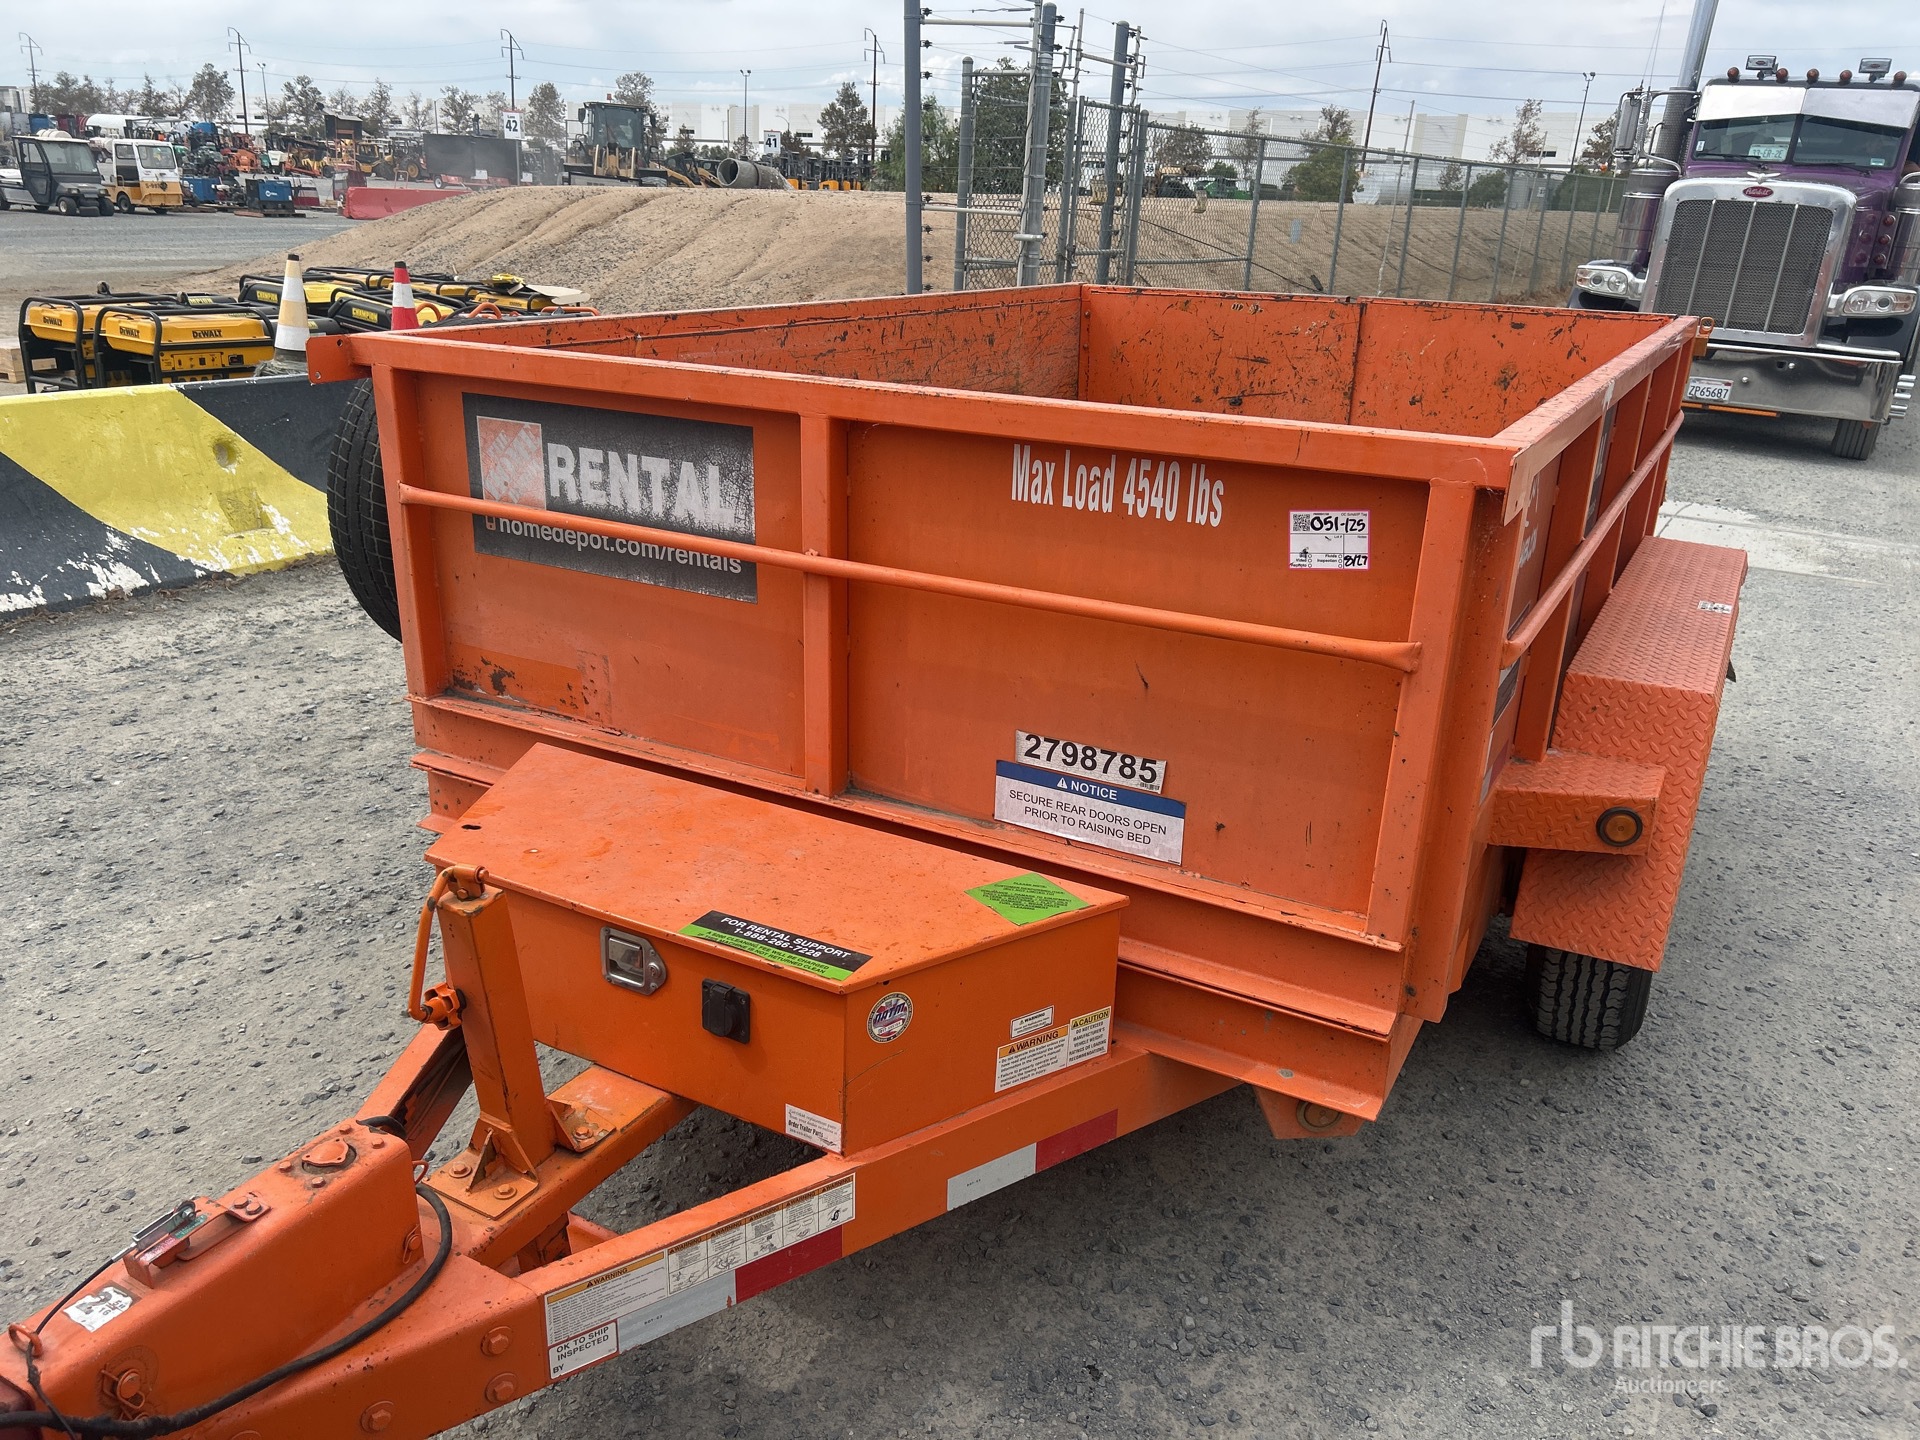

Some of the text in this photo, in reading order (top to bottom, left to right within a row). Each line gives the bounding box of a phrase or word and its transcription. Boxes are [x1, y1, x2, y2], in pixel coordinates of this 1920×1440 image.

[506, 120, 518, 132] 42
[766, 138, 777, 148] 41
[192, 329, 222, 339] DEWALT
[1688, 386, 1728, 398] ZP65687
[547, 442, 736, 525] RENTAL
[1011, 444, 1225, 528] Max Load 4540 lbs
[1024, 734, 1158, 784] 2798785
[1071, 780, 1118, 801] NOTICE
[1009, 789, 1167, 835] SECURE REAR DOORS OPEN
[1024, 806, 1151, 845] PRIOR TO RAISING BED
[720, 917, 852, 959] FOR RENTAL SUPPORT
[734, 928, 822, 958] 1-888-266-7228
[726, 936, 759, 948] CLEANING
[798, 958, 830, 970] CHARGED
[768, 954, 803, 966] RETURNED
[803, 964, 826, 974] CLEAN
[1078, 1010, 1109, 1026] CAUTION
[1016, 1030, 1059, 1051] WARNING
[800, 1123, 812, 1134] Trailer
[594, 1268, 628, 1286] WARNING
[556, 1326, 609, 1354] OK TO SHIP
[557, 1334, 609, 1362] INSPECTED
[552, 1364, 564, 1374] BY
